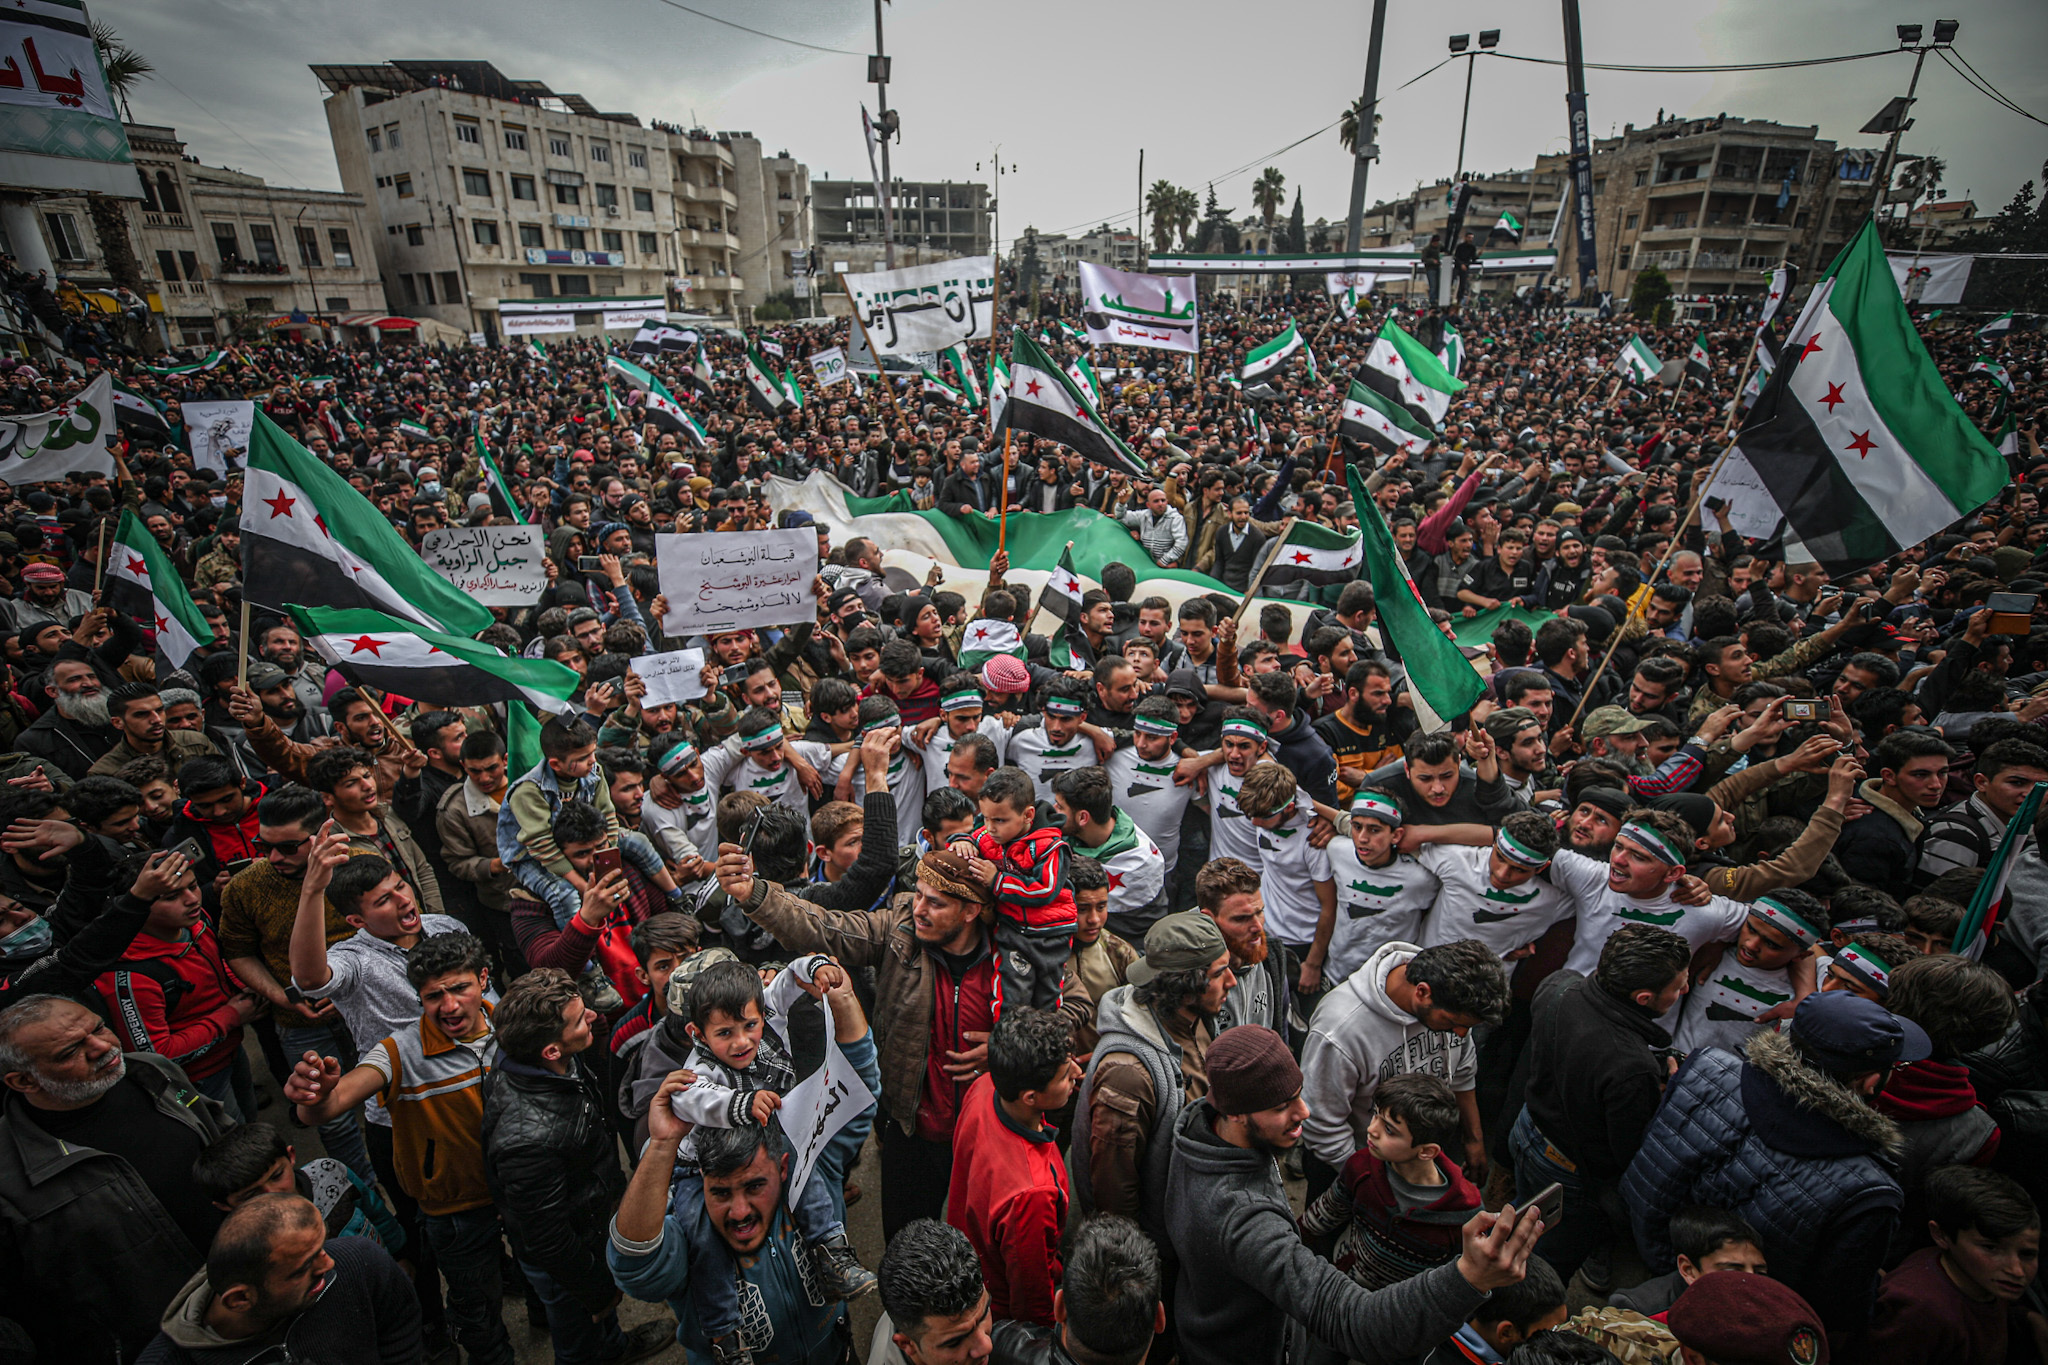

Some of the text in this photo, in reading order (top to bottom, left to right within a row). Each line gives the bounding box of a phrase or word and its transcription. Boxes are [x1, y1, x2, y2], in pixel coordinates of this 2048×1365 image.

[425, 534, 441, 553] في
[492, 531, 531, 550] نحن
[437, 548, 528, 573] جبل الزاوية
[761, 543, 795, 563] قبيلة
[120, 998, 147, 1047] SUPERDRY
